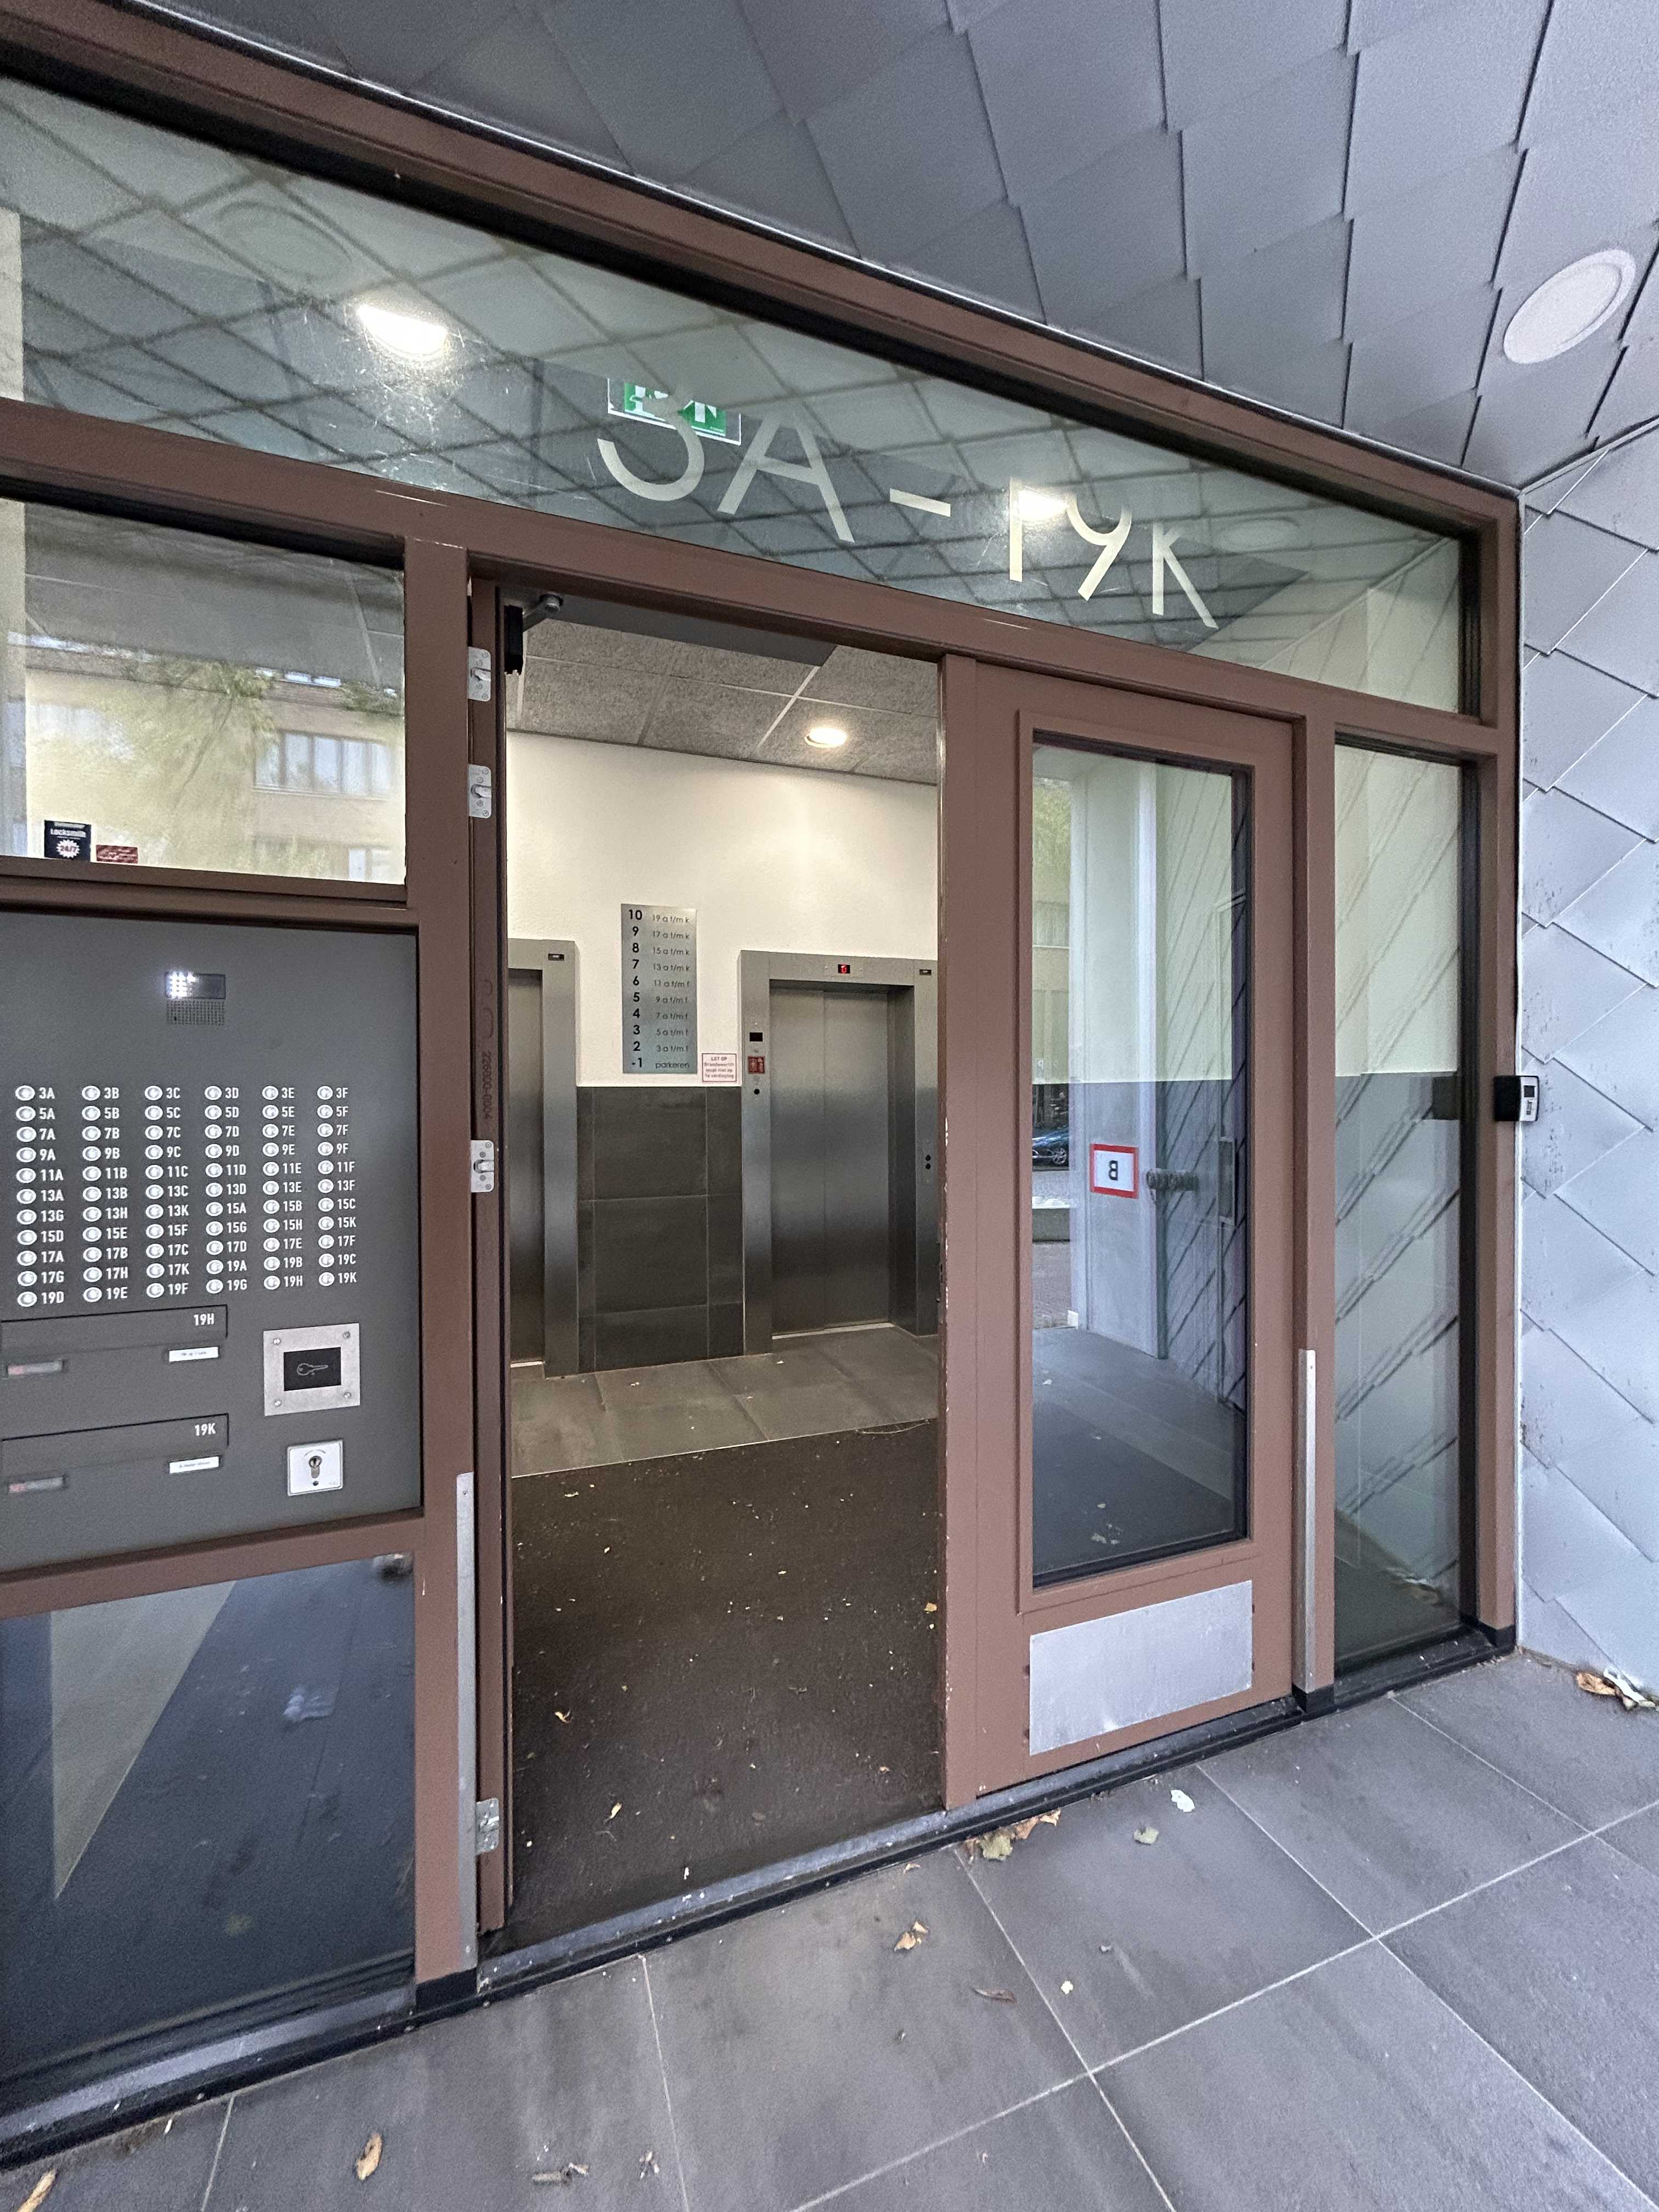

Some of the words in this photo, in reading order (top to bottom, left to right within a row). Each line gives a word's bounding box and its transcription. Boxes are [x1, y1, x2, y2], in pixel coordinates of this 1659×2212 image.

[629, 909, 642, 920] 10
[632, 926, 639, 936] 9
[632, 943, 639, 953] 8
[632, 959, 639, 969] 7
[633, 975, 640, 986] 6
[633, 992, 640, 1002] 5
[633, 1008, 640, 1018] 4
[633, 1024, 640, 1035] 3
[633, 1041, 641, 1051] 2
[631, 1058, 642, 1068] -1
[38, 1087, 55, 1099] 3A
[104, 1087, 120, 1099] 3B
[166, 1087, 180, 1099] 3C
[224, 1087, 239, 1099] 3D
[281, 1087, 295, 1099] 3E
[336, 1087, 348, 1099] 3F
[39, 1107, 55, 1120] 5A
[104, 1107, 120, 1119] 5B
[166, 1107, 181, 1119] 5C
[225, 1106, 239, 1118] 5D
[281, 1106, 295, 1118] 5E
[336, 1105, 349, 1117] 5F
[39, 1128, 56, 1141] 7A
[104, 1127, 120, 1139] 7B
[166, 1126, 181, 1138] 7C
[225, 1125, 240, 1137] 7D
[281, 1125, 295, 1137] 7E
[336, 1124, 349, 1136] 7F
[40, 1148, 56, 1161] 9A
[104, 1147, 120, 1159] 9B
[166, 1146, 182, 1158] 9C
[225, 1144, 240, 1157] 9D
[282, 1144, 296, 1155] 9E
[336, 1143, 349, 1154] 9F
[40, 1169, 64, 1181] 11A
[105, 1167, 128, 1180] 11B
[167, 1165, 189, 1178] 11C
[226, 1164, 246, 1176] 11D
[283, 1163, 302, 1174] 11E
[337, 1161, 356, 1172] 11F
[40, 1189, 64, 1202] 13A
[105, 1187, 128, 1199] 13B
[167, 1185, 189, 1197] 13C
[226, 1183, 247, 1195] 13D
[283, 1181, 302, 1193] 13E
[337, 1180, 356, 1191] 13F
[41, 1209, 64, 1222] 13G
[105, 1206, 128, 1220] 13H
[167, 1204, 189, 1217] 13K
[227, 1202, 247, 1214] 15A
[283, 1200, 302, 1212] 15B
[337, 1198, 356, 1210] 15C
[41, 1229, 64, 1243] 15D
[105, 1227, 128, 1239] 15E
[167, 1224, 188, 1237] 15F
[226, 1221, 247, 1234] 15G
[283, 1218, 303, 1231] 15H
[337, 1216, 357, 1228] 15K
[41, 1250, 64, 1263] 17A
[106, 1246, 128, 1260] 17B
[167, 1243, 189, 1256] 17C
[227, 1240, 247, 1253] 17D
[283, 1237, 303, 1250] 17E
[337, 1235, 356, 1247] 17F
[41, 1270, 64, 1284] 17G
[106, 1266, 128, 1280] 17H
[168, 1263, 190, 1276] 17K
[227, 1260, 247, 1272] 19A
[283, 1256, 303, 1268] 19B
[337, 1253, 357, 1266] 19C
[41, 1291, 64, 1304] 19D
[106, 1286, 128, 1300] 19E
[168, 1282, 189, 1295] 19F
[227, 1278, 247, 1291] 19G
[284, 1275, 303, 1288] 19H
[338, 1272, 357, 1284] 19K
[193, 1313, 215, 1326] 19H
[194, 1423, 216, 1436] 19K
